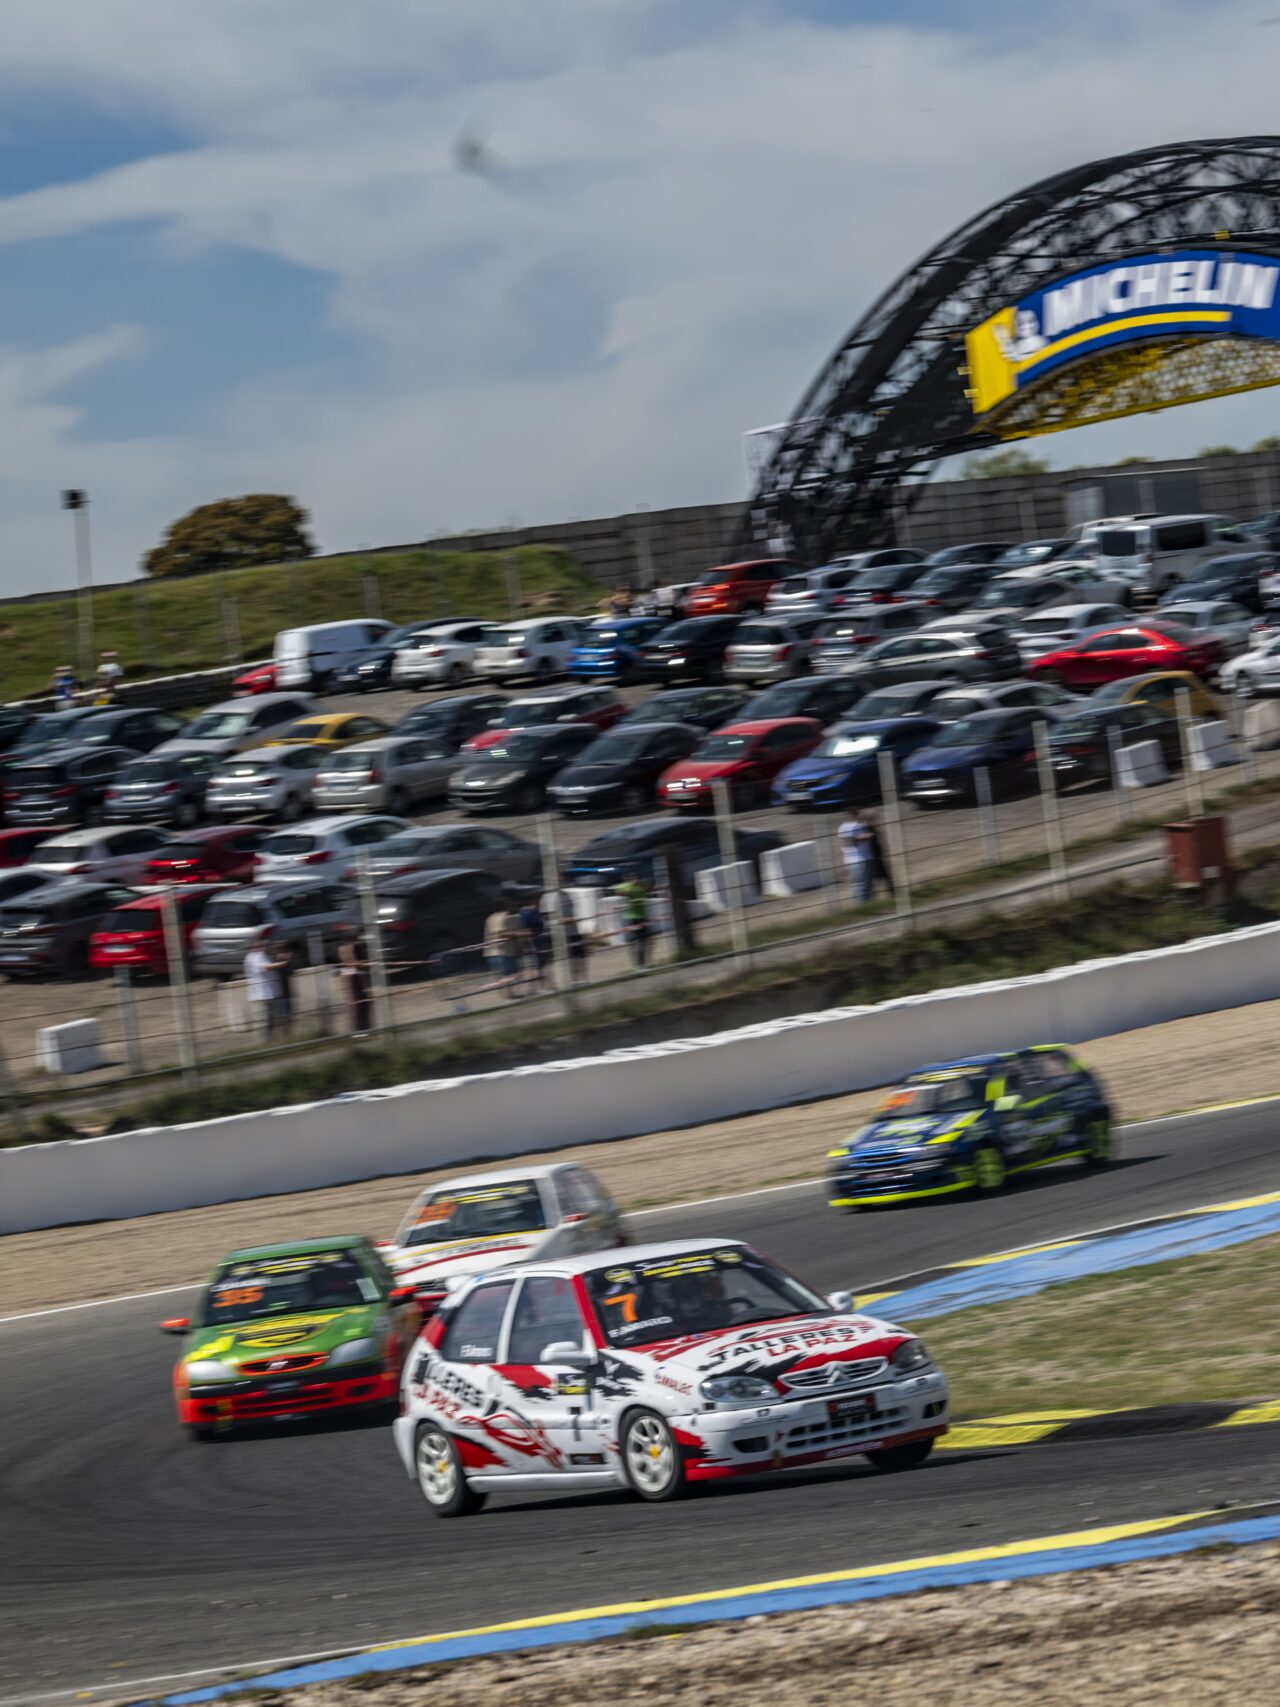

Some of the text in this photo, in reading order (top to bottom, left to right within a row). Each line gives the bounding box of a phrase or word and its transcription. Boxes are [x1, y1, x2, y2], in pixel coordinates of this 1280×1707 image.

[1043, 260, 1280, 337] MICHELIN
[604, 1293, 639, 1323] 7
[709, 1327, 856, 1361] TALLERES
[767, 1333, 858, 1358] LA PAZ
